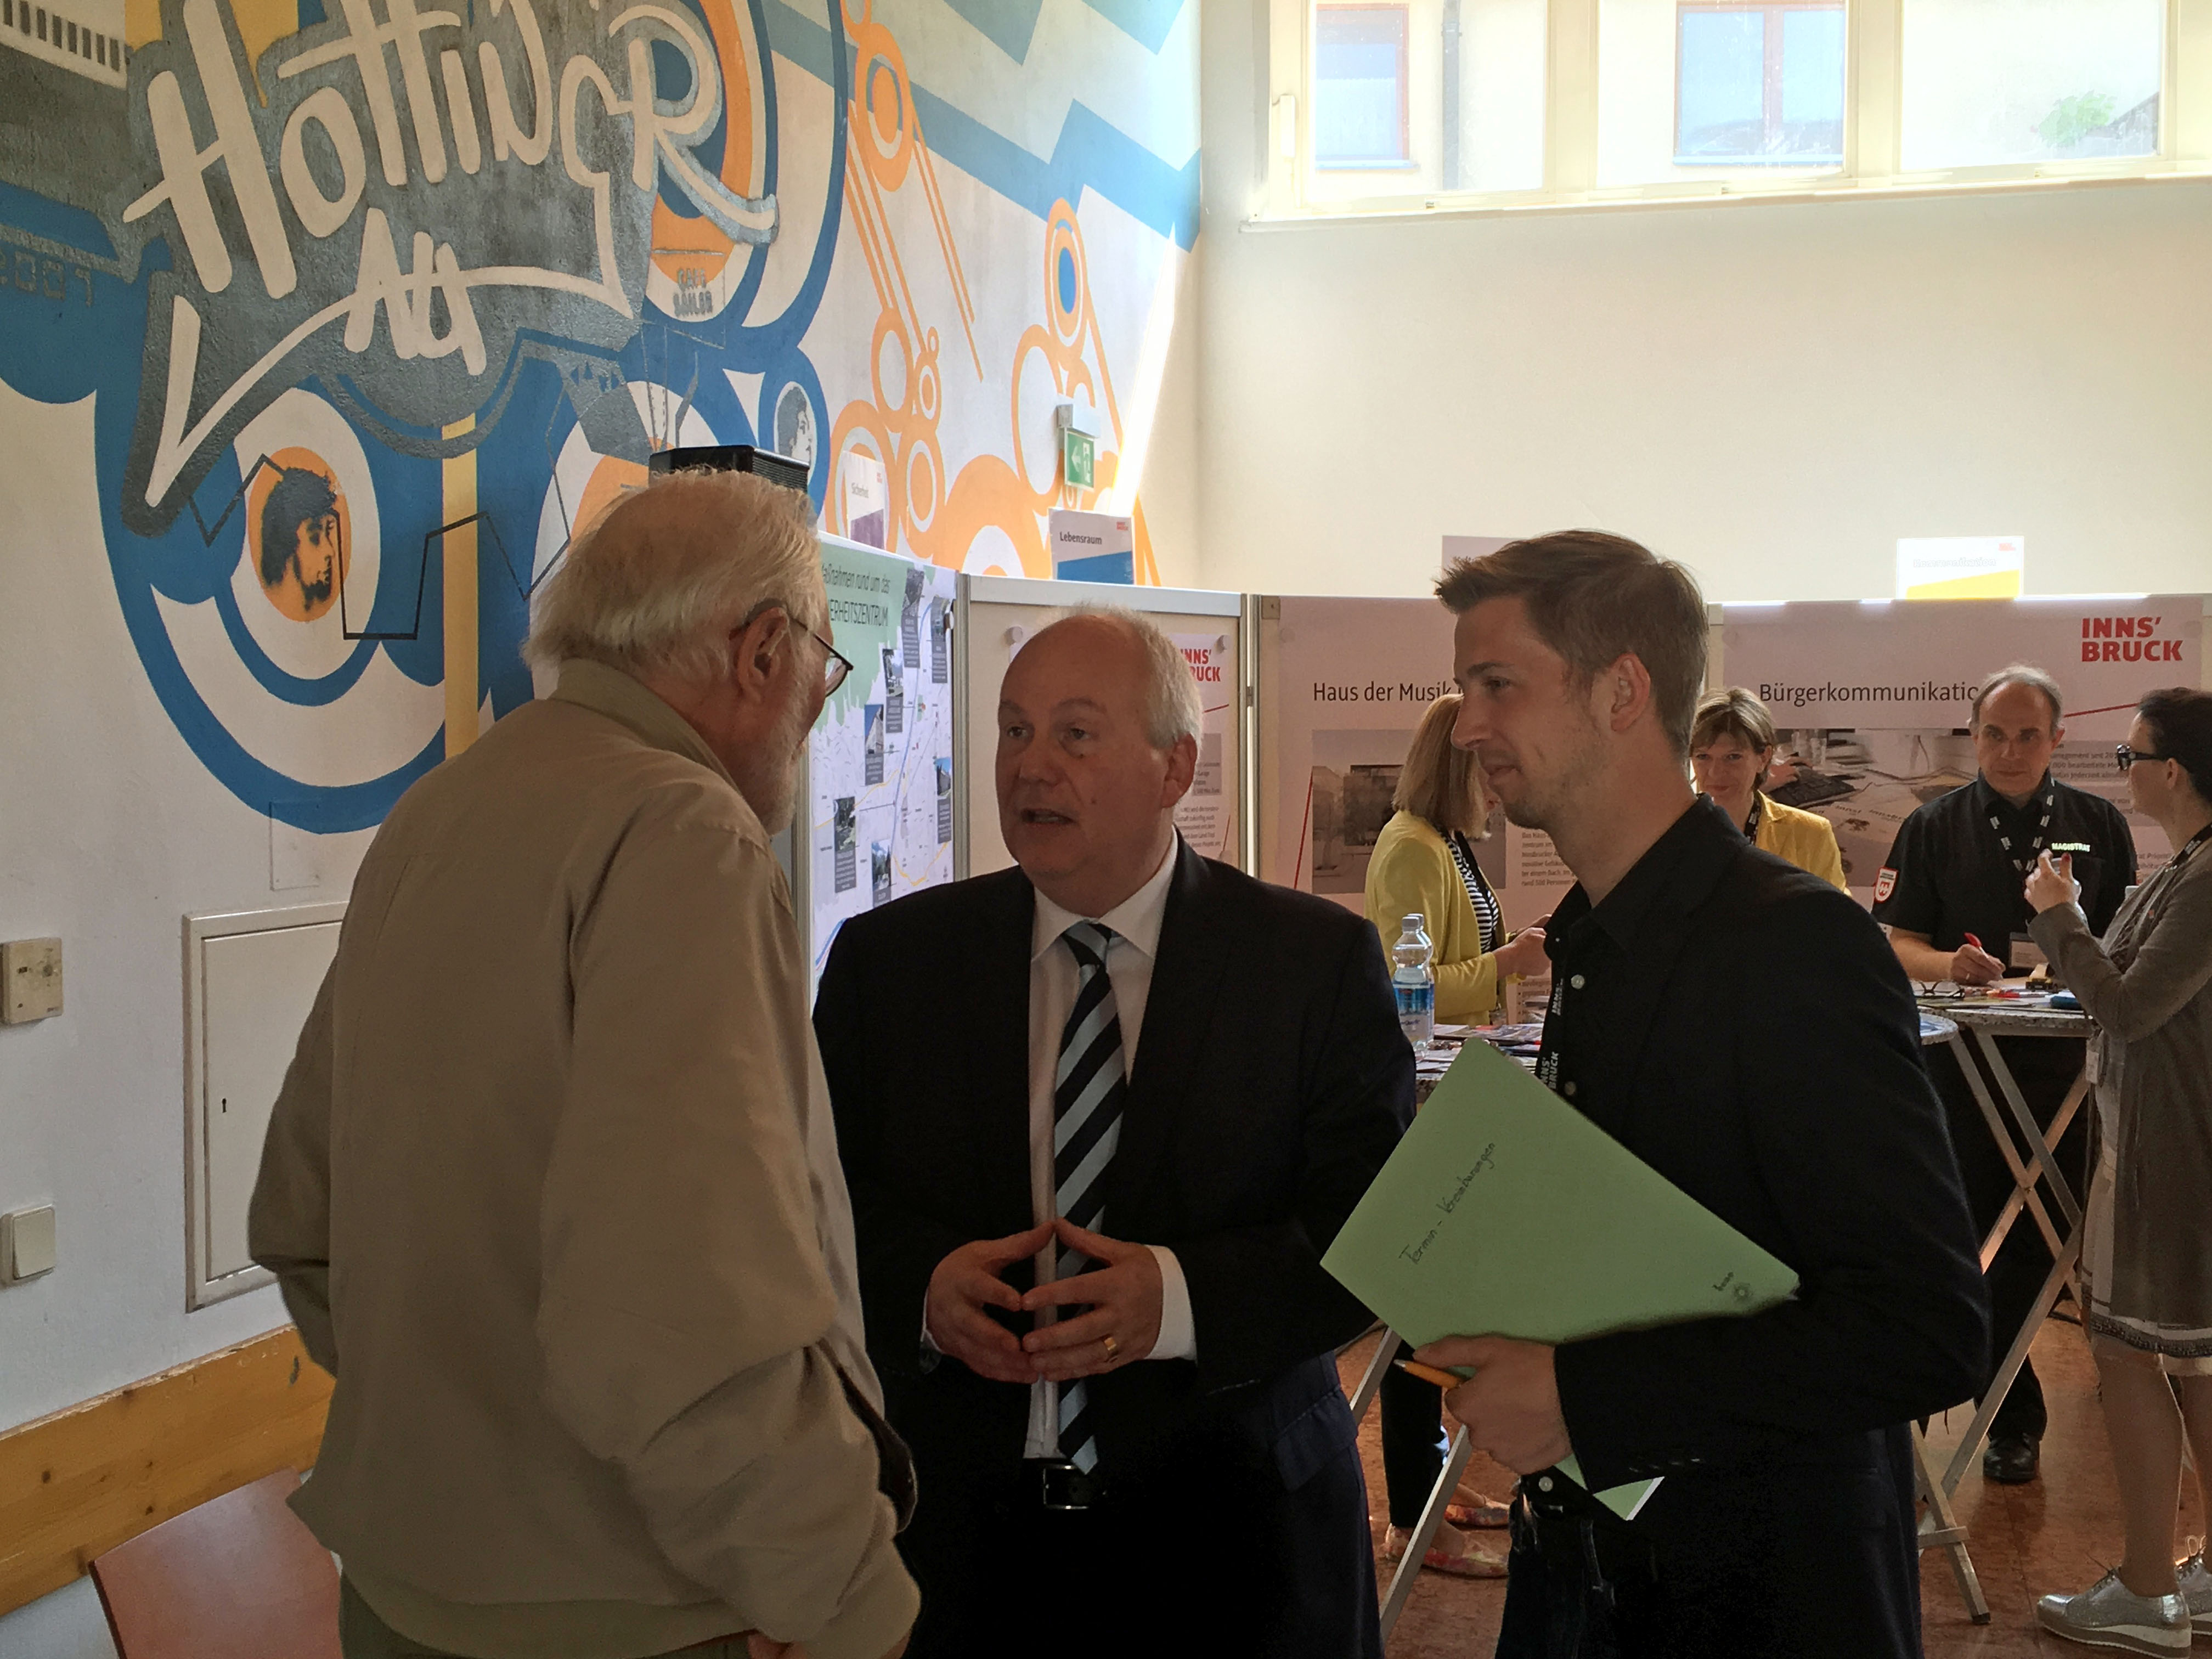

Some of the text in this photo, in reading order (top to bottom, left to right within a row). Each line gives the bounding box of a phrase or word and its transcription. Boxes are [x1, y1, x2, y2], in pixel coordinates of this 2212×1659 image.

[1059, 531, 1102, 545] Lebensraum
[828, 599, 889, 627] ERHEITSZENTRUM
[2082, 640, 2183, 662] BRUCK
[1189, 666, 1221, 681] RUCK
[1313, 681, 1452, 701] Haus der Musik
[1759, 681, 1979, 707] Bürgerkommunikatio
[2051, 843, 2091, 853] MAGISTRAT
[1548, 1051, 1559, 1090] BRUCK
